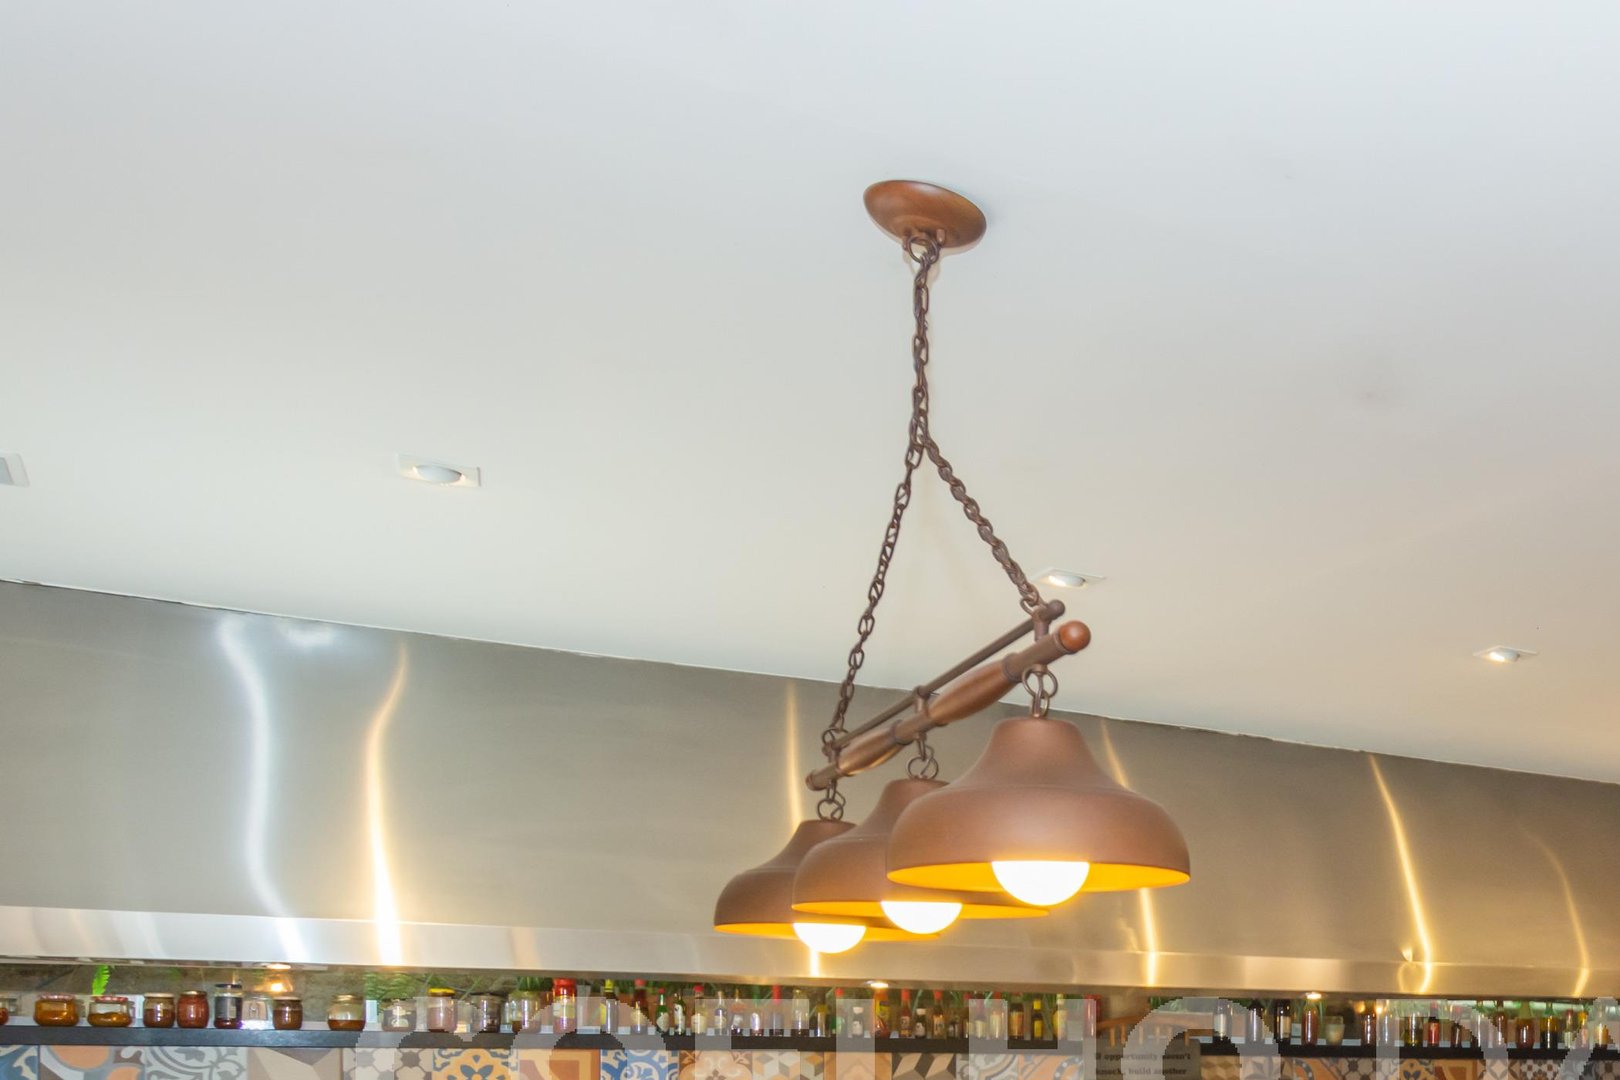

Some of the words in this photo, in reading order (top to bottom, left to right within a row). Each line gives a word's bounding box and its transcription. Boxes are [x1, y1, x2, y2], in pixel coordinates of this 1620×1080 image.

[1104, 1053, 1158, 1062] opportunity
[1128, 1066, 1151, 1075] build
[1153, 1067, 1187, 1076] another
